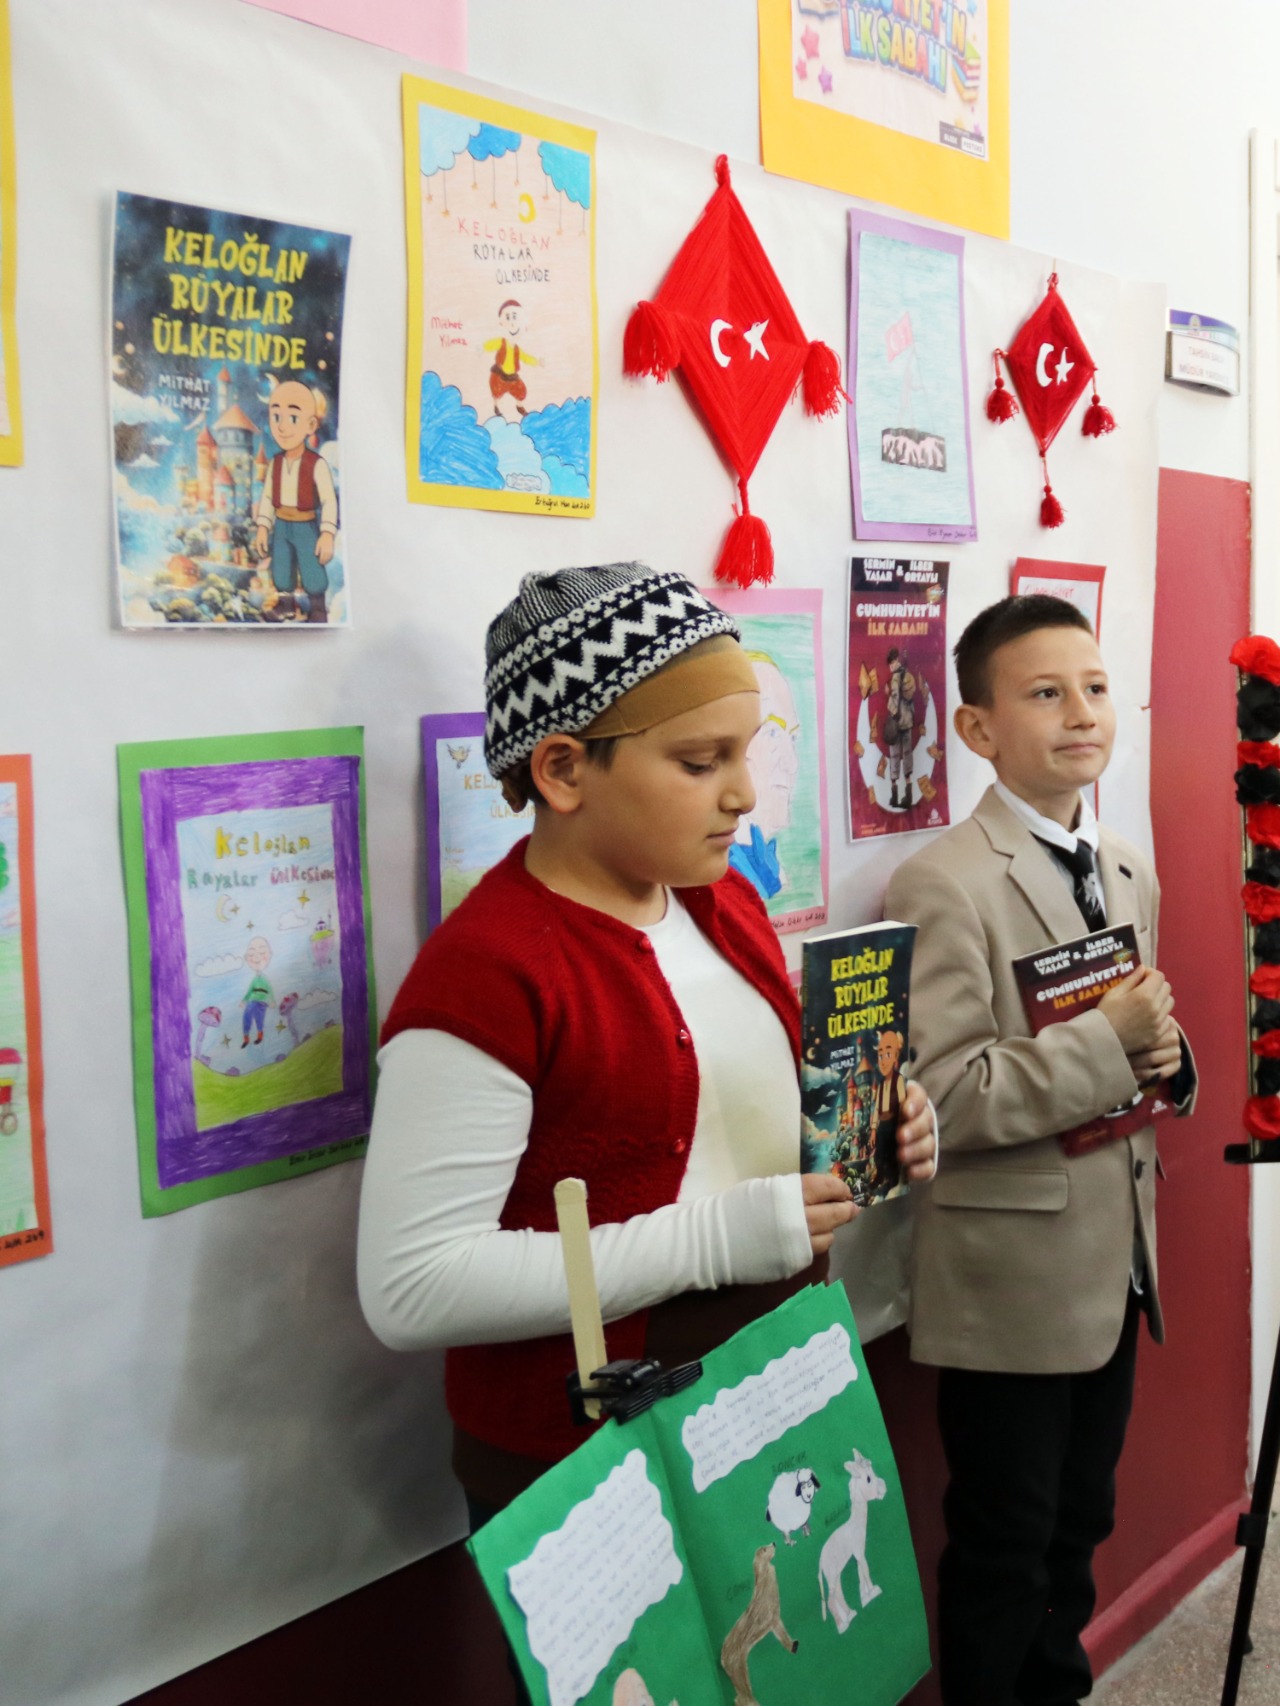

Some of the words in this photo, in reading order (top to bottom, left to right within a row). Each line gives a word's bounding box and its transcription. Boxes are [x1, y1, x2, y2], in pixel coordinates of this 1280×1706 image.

[877, 14, 948, 93] SABAHI
[163, 226, 308, 284] KELOĞLAN
[169, 273, 294, 325] RÜYALAR
[152, 313, 307, 369] ÜLKESİNDE
[856, 599, 940, 618] CUMHURİYET'İN
[867, 618, 886, 636] İLK
[831, 947, 895, 982] KELOĞLAN
[1034, 950, 1070, 968] SERMİN
[1073, 951, 1082, 960] &
[1038, 960, 1071, 975] YAŞAR
[1083, 941, 1124, 960] ORTAYLI
[834, 976, 889, 1009] RÜYALAR
[1036, 961, 1134, 1002] CUMHURİYET'İN
[1053, 994, 1076, 1010] İLK
[827, 1002, 895, 1039] ÜLKESİNDE
